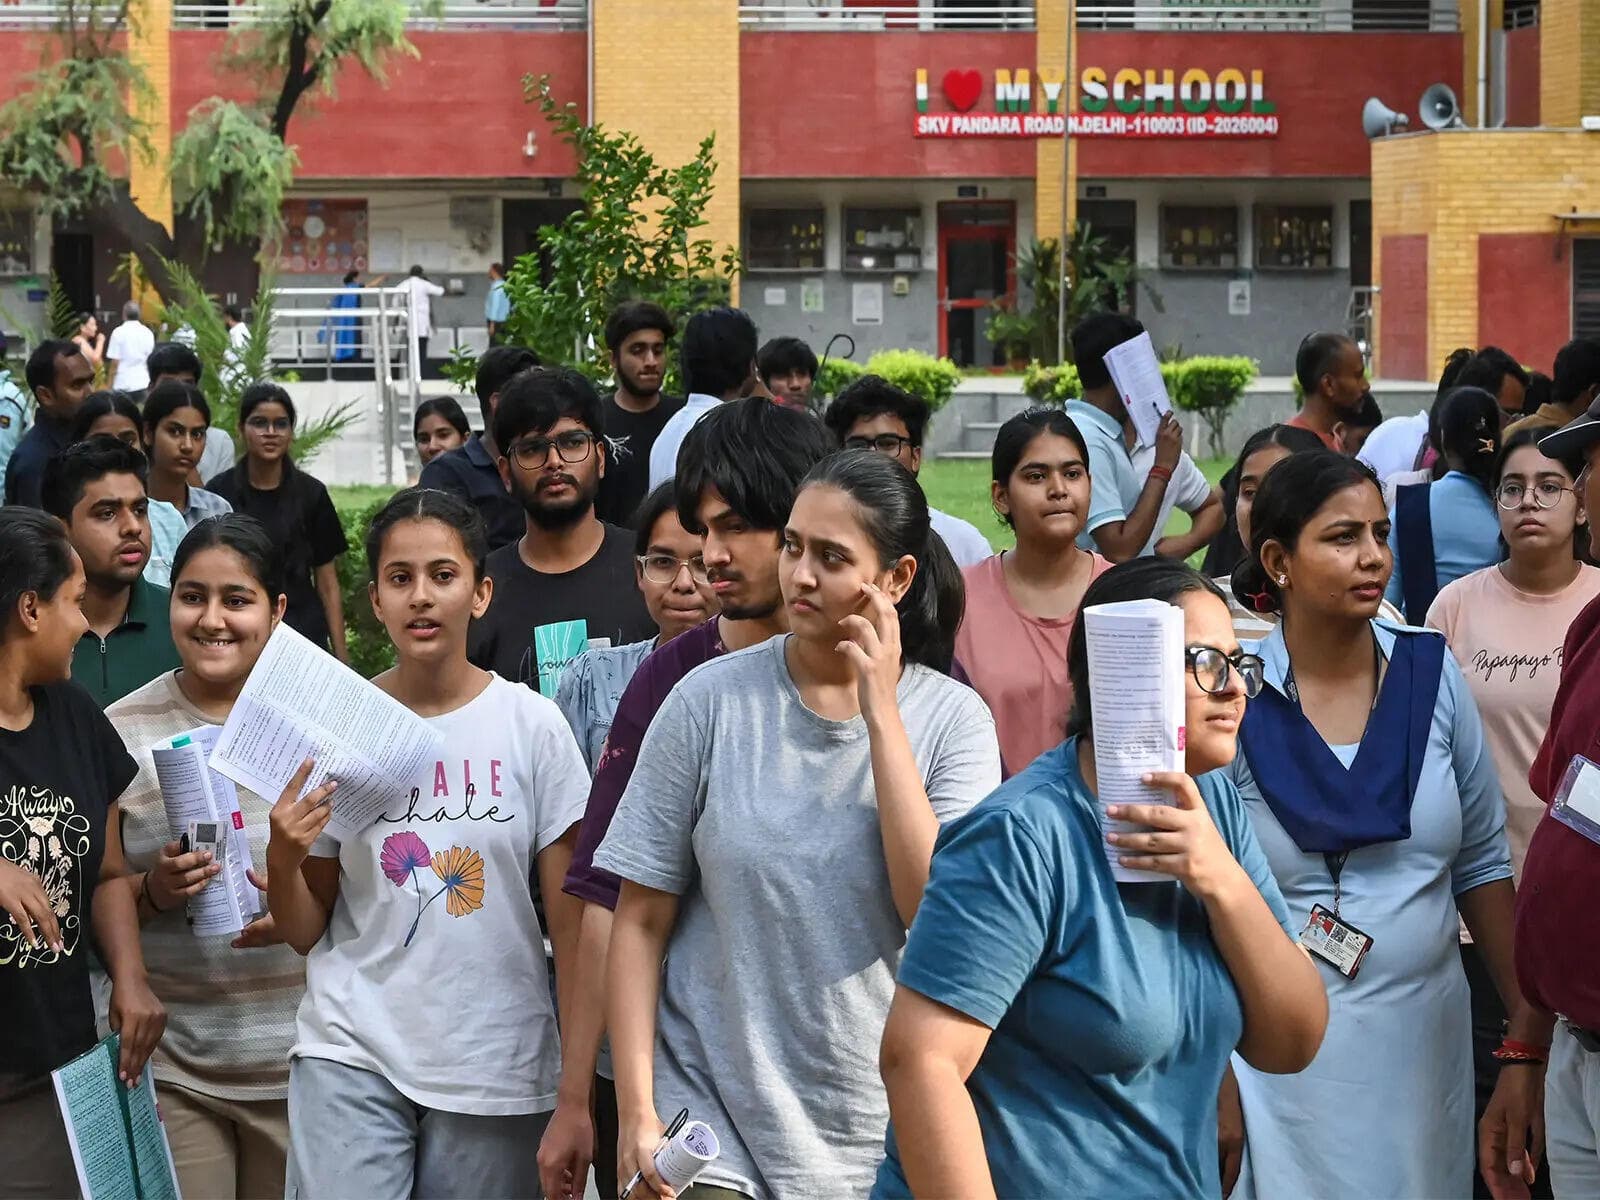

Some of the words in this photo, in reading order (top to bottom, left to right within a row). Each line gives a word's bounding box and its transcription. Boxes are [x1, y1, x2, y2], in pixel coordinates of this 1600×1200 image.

[915, 69, 929, 113] I
[995, 69, 1067, 113] MY
[1081, 67, 1276, 114] SCHOOL
[918, 116, 949, 134] SKV
[951, 116, 1021, 134] PANDARA
[1186, 116, 1279, 134] (ID-2026004)
[1472, 649, 1551, 682] Papagayo
[432, 759, 503, 798] ALE
[0, 785, 75, 822] Always
